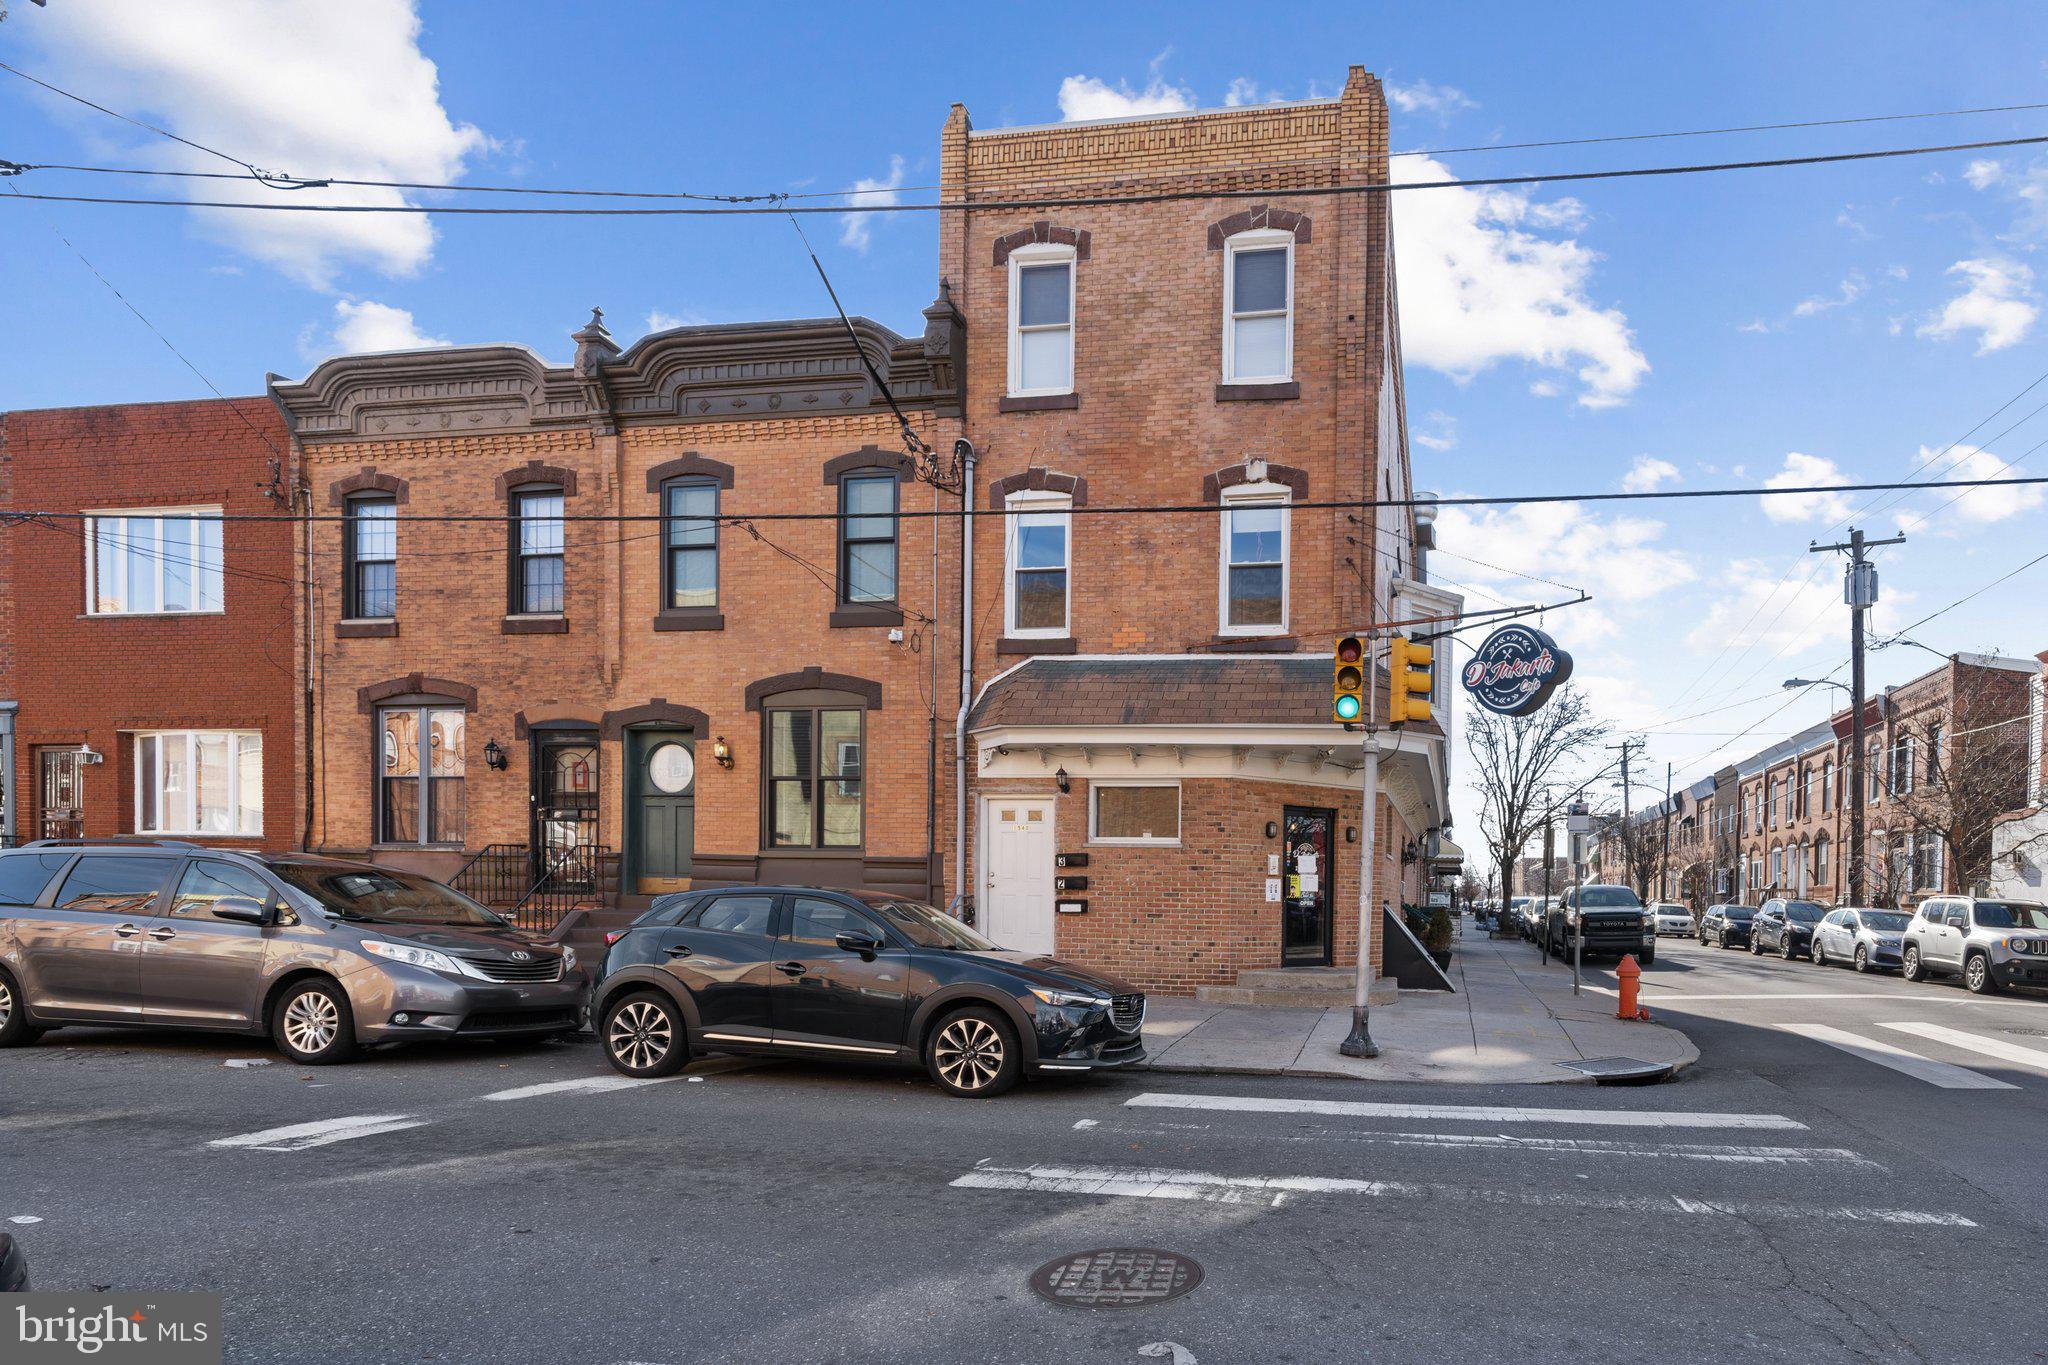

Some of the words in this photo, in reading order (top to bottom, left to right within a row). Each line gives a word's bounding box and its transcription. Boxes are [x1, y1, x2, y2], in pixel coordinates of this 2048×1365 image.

[1466, 648, 1555, 687] D'Jakarta
[1520, 678, 1541, 694] Cafe
[1058, 857, 1065, 866] 3
[1057, 879, 1065, 889] 2
